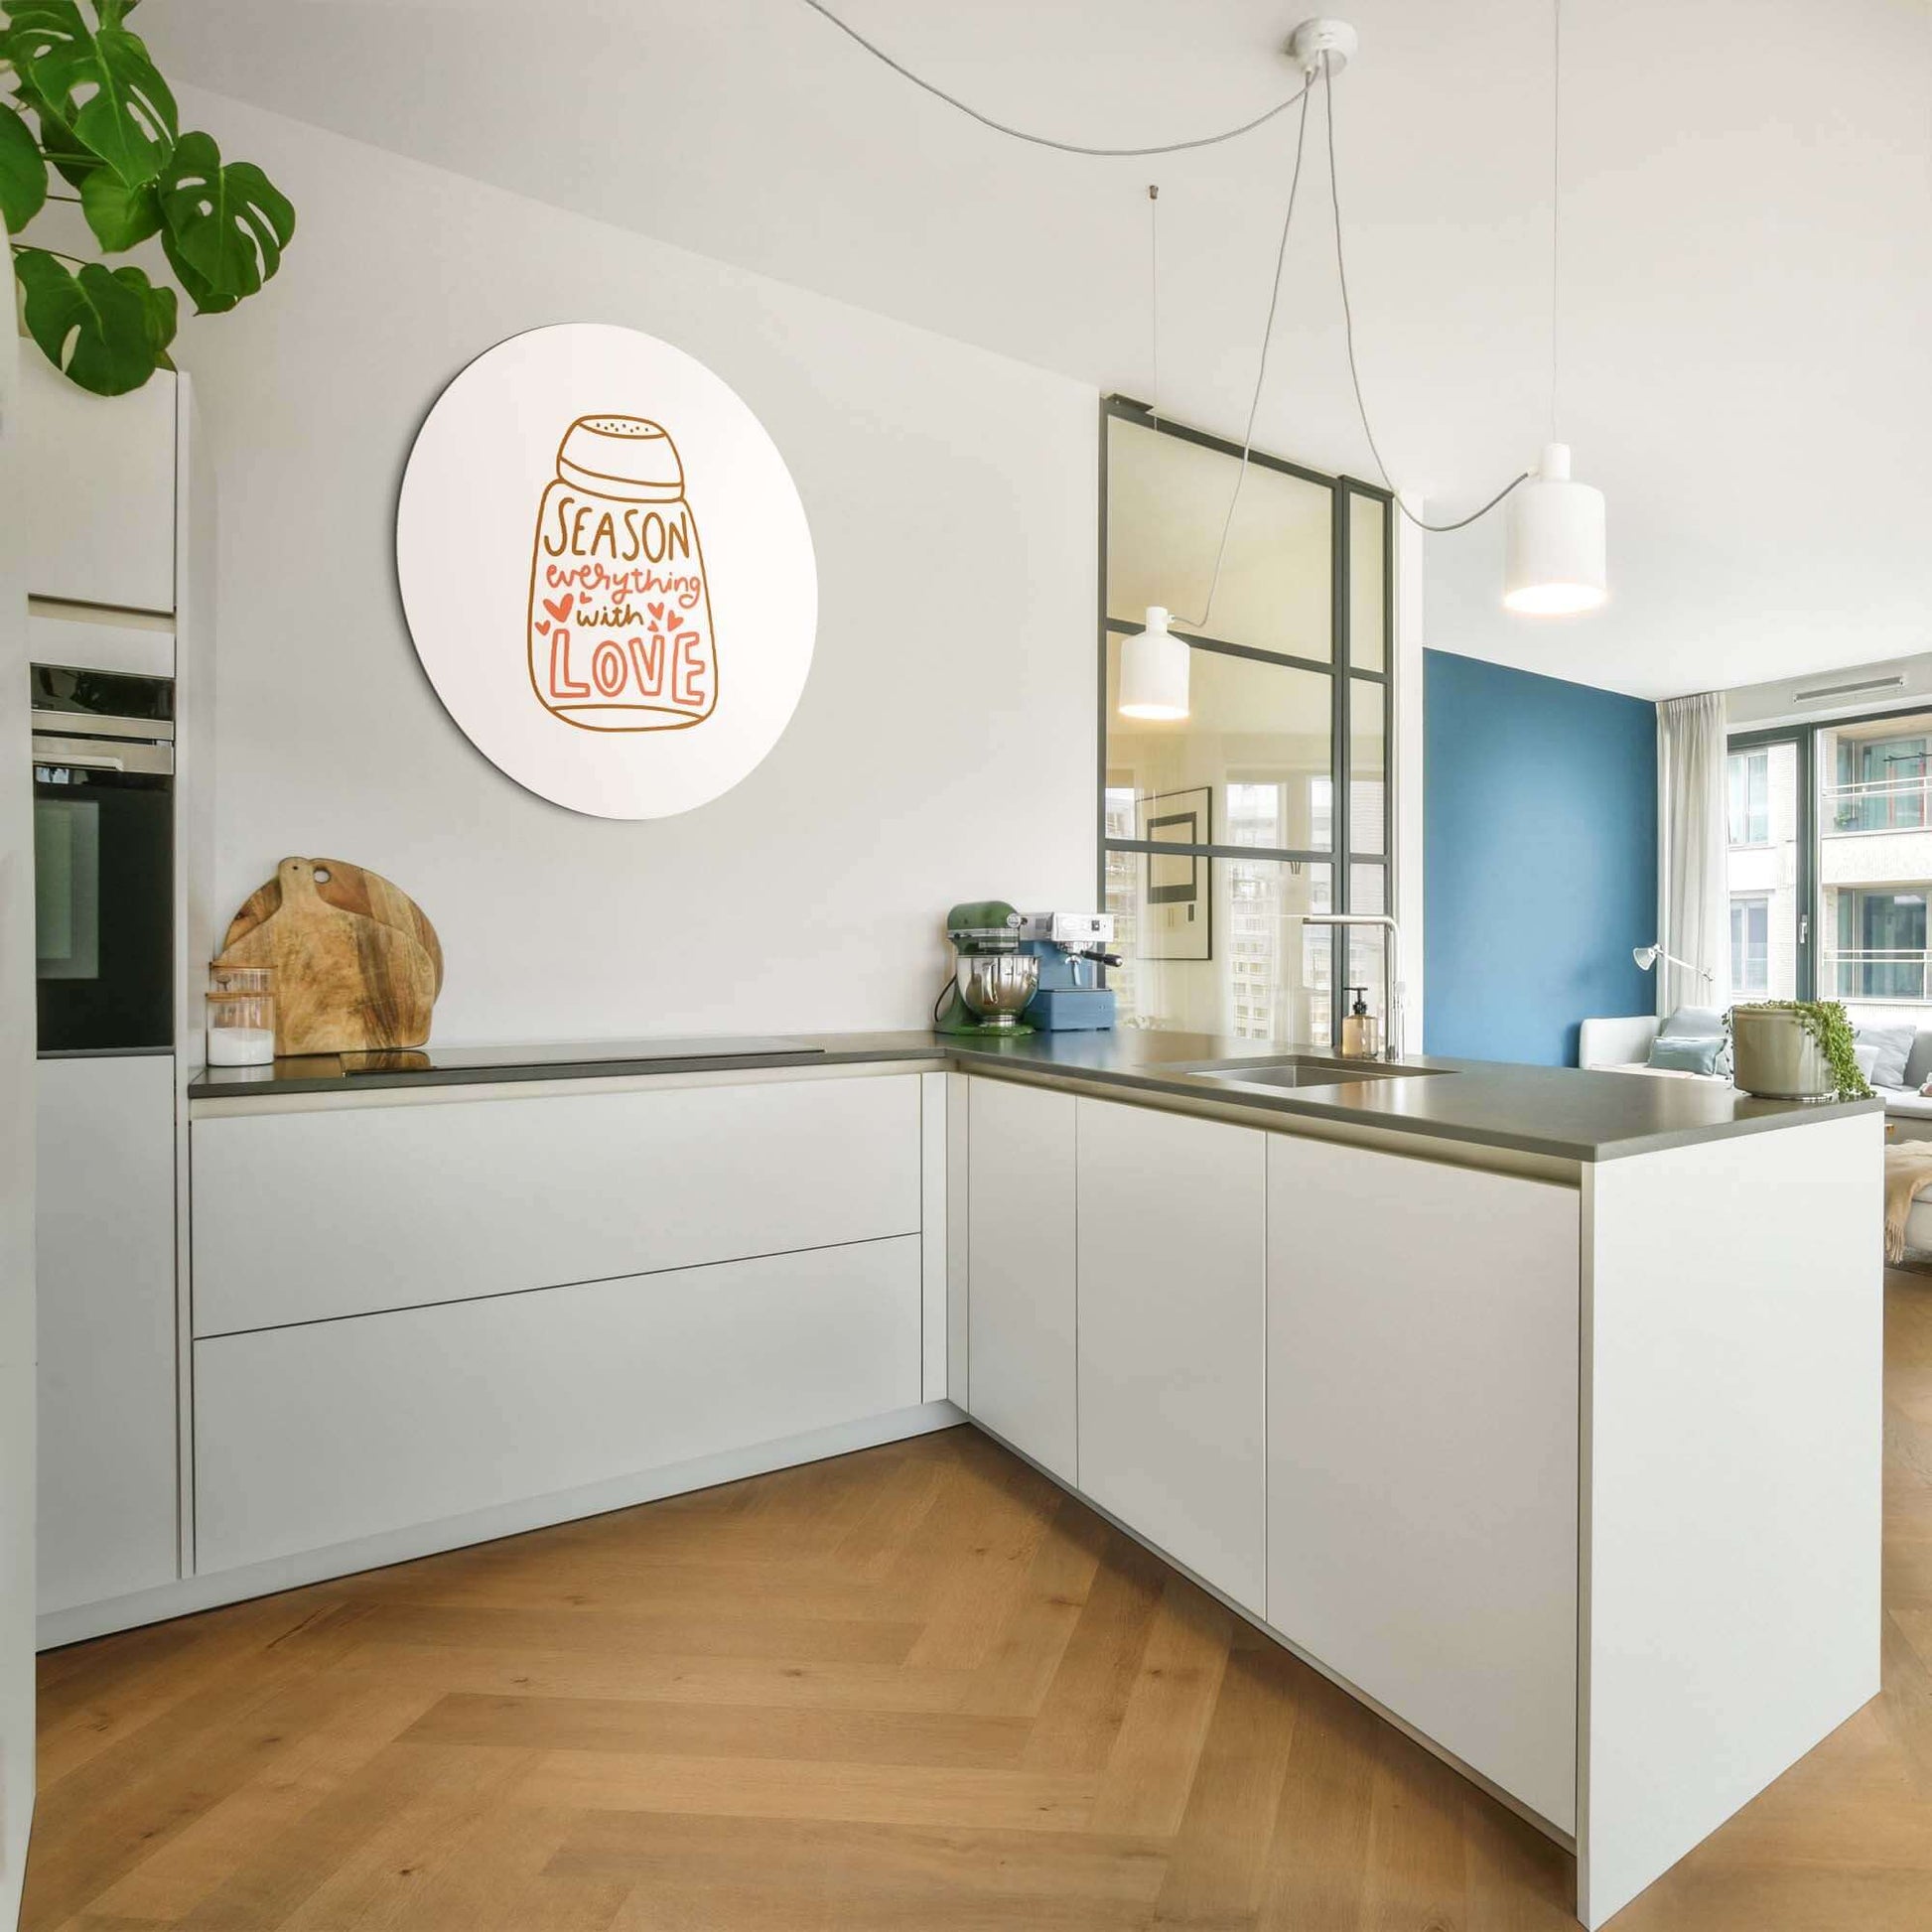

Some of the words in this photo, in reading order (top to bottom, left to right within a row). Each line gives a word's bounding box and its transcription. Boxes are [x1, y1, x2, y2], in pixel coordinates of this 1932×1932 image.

[543, 496, 690, 563] SEASON
[545, 563, 701, 609] everything
[576, 604, 644, 627] with
[549, 628, 706, 706] LOVE
